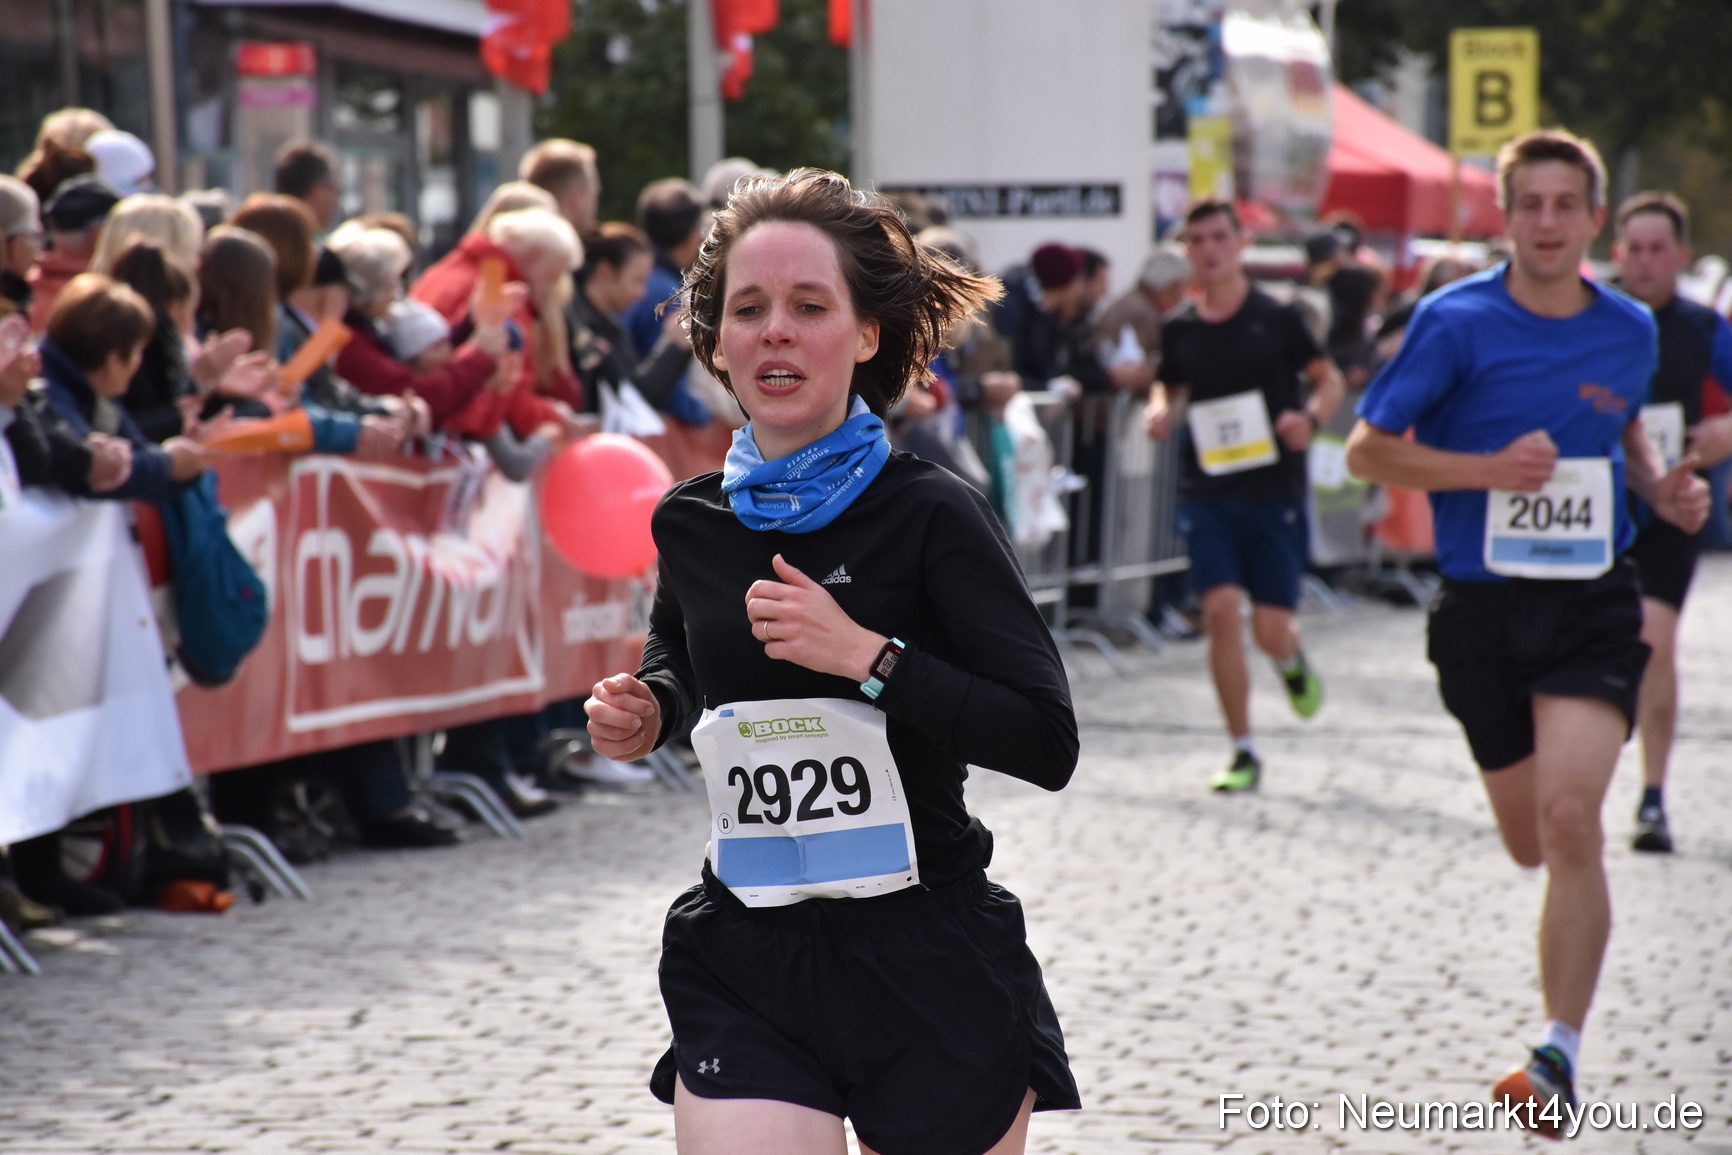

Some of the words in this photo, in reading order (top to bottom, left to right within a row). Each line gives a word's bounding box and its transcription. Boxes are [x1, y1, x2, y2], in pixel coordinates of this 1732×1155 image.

[1475, 71, 1513, 127] B
[785, 447, 831, 480] engelhorn
[1508, 496, 1593, 531] 2044
[821, 575, 852, 585] adidas
[753, 717, 826, 738] BOCK
[755, 735, 779, 744] inspired
[728, 756, 871, 825] 2929
[722, 818, 729, 829] D
